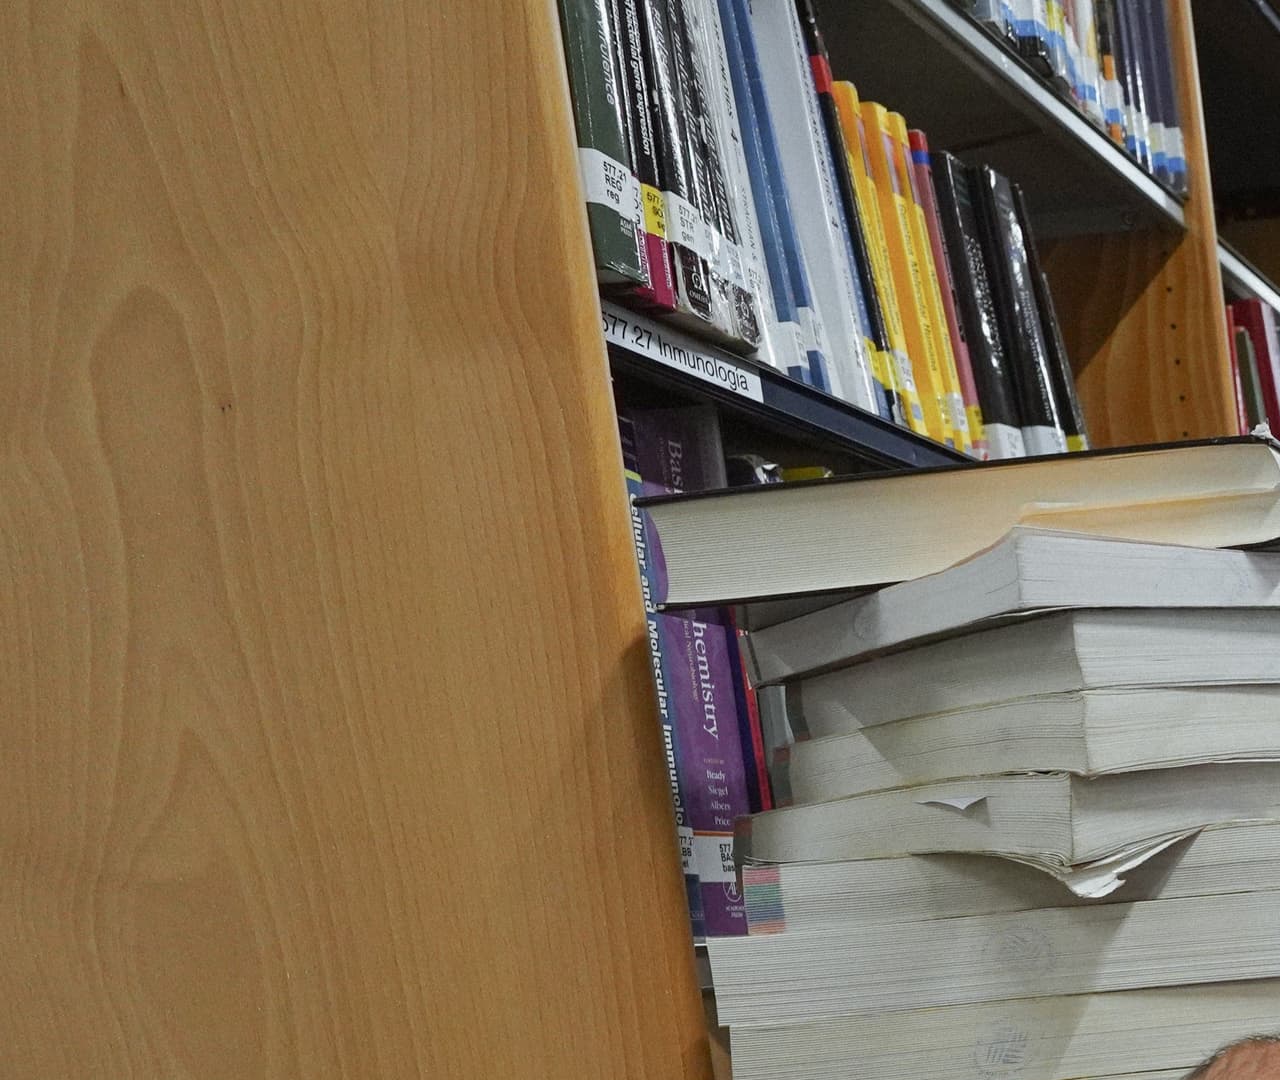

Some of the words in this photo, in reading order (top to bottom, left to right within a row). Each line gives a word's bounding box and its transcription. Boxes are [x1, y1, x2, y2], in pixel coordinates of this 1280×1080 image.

[631, 60, 643, 91] gene
[636, 92, 652, 155] expression
[605, 174, 622, 192] REG
[606, 190, 620, 204] reg
[602, 311, 652, 351] 577.27
[657, 335, 750, 391] Inmunología
[630, 493, 648, 570] Cellular
[641, 575, 656, 615] and
[647, 620, 669, 718] Molecular
[692, 620, 719, 740] hemistry
[662, 724, 684, 825] Immunolo
[708, 785, 728, 796] Siegel
[714, 815, 730, 826] Price
